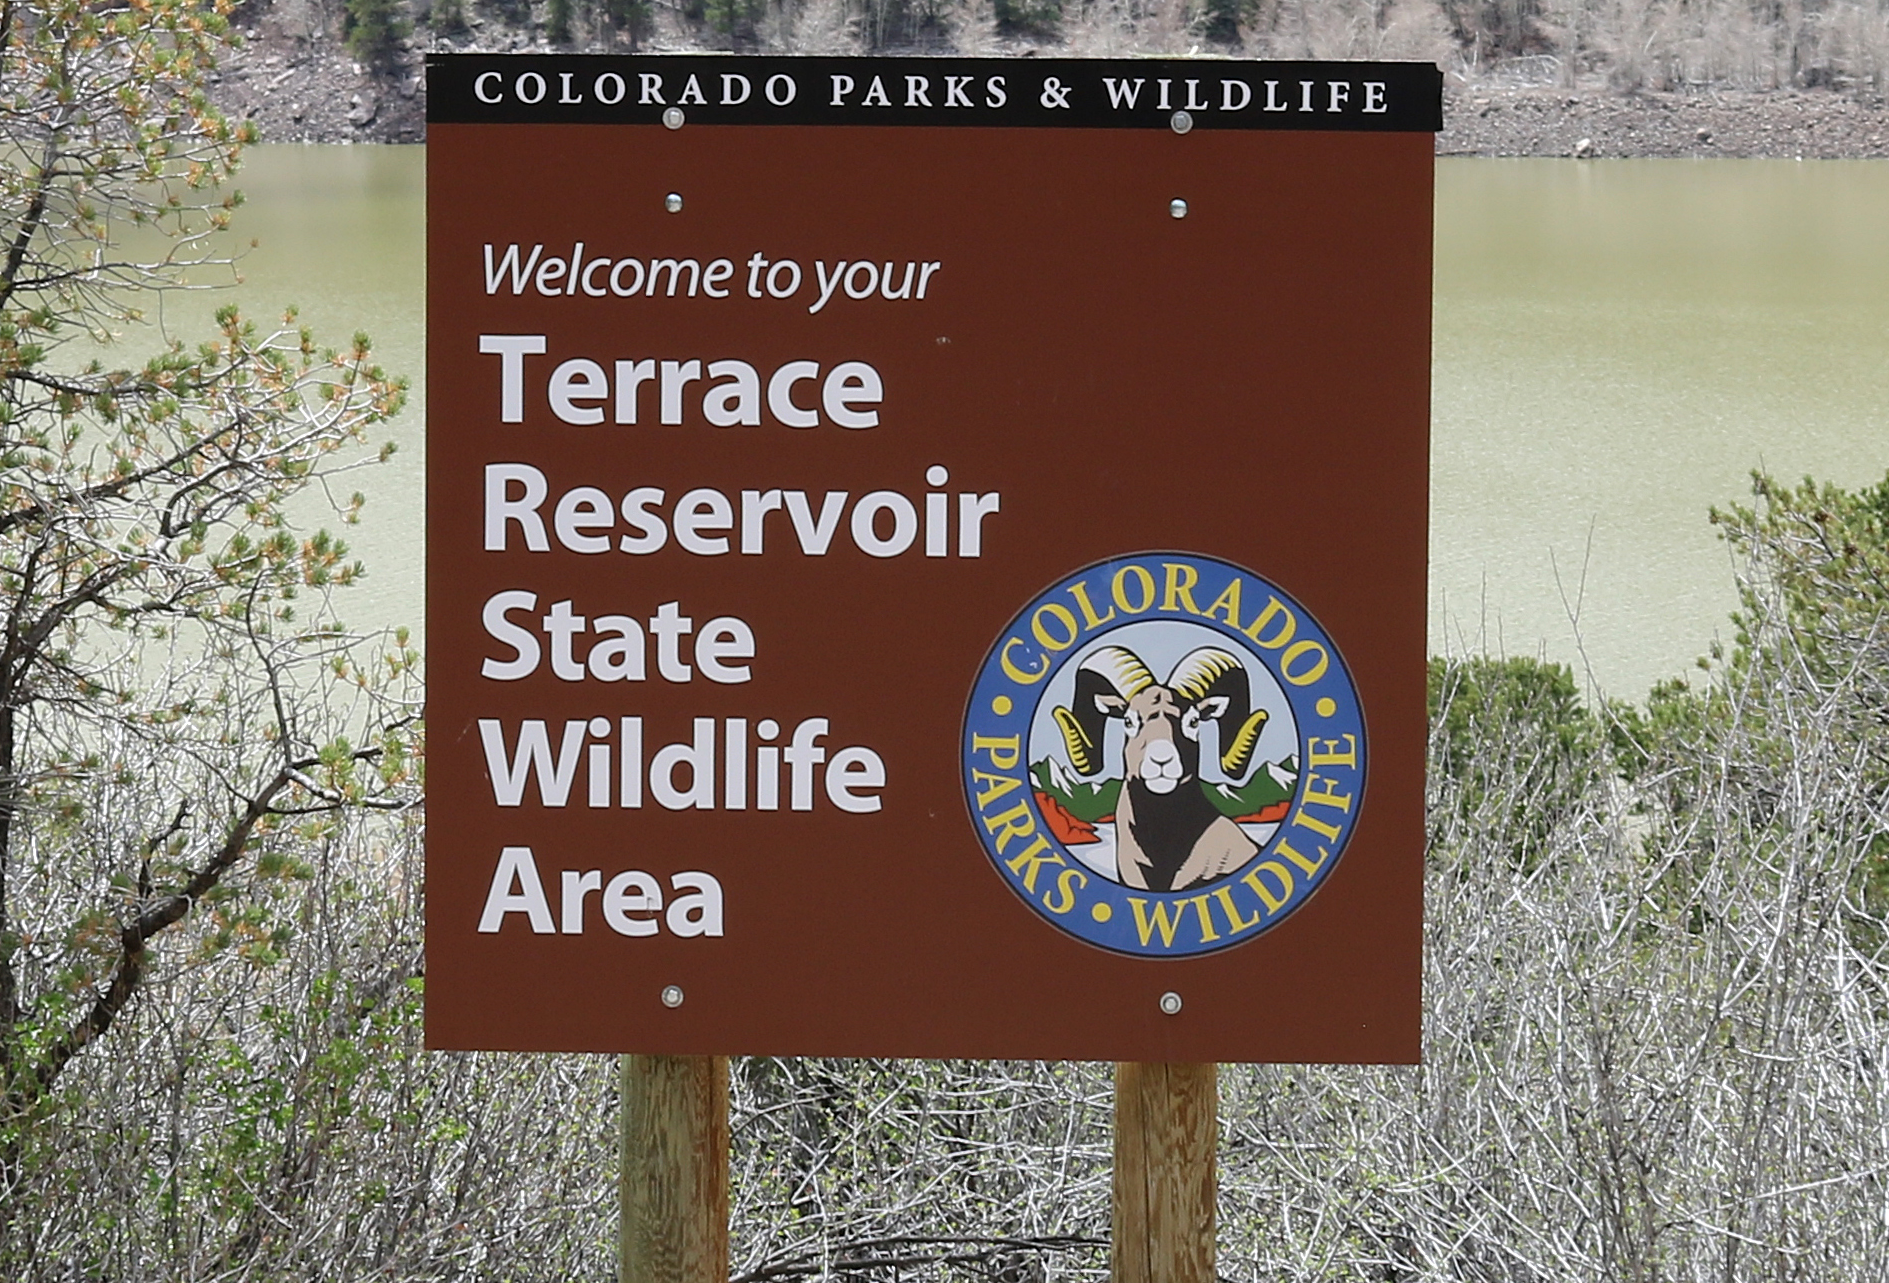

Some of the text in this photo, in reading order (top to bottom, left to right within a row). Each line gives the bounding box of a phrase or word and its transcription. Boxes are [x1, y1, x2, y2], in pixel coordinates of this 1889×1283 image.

[474, 71, 1388, 113] COLORADO PARKS & WILDLIFE
[484, 242, 941, 314] Welcome to your
[479, 334, 883, 429] Terrace
[484, 463, 1000, 558] Reservoir
[481, 590, 755, 684] State
[998, 562, 1331, 687] COLORADO
[477, 716, 886, 813] Wildlife
[971, 731, 1089, 916] PARKS
[1126, 731, 1358, 949] WILDLIFE
[477, 846, 724, 938] Area
